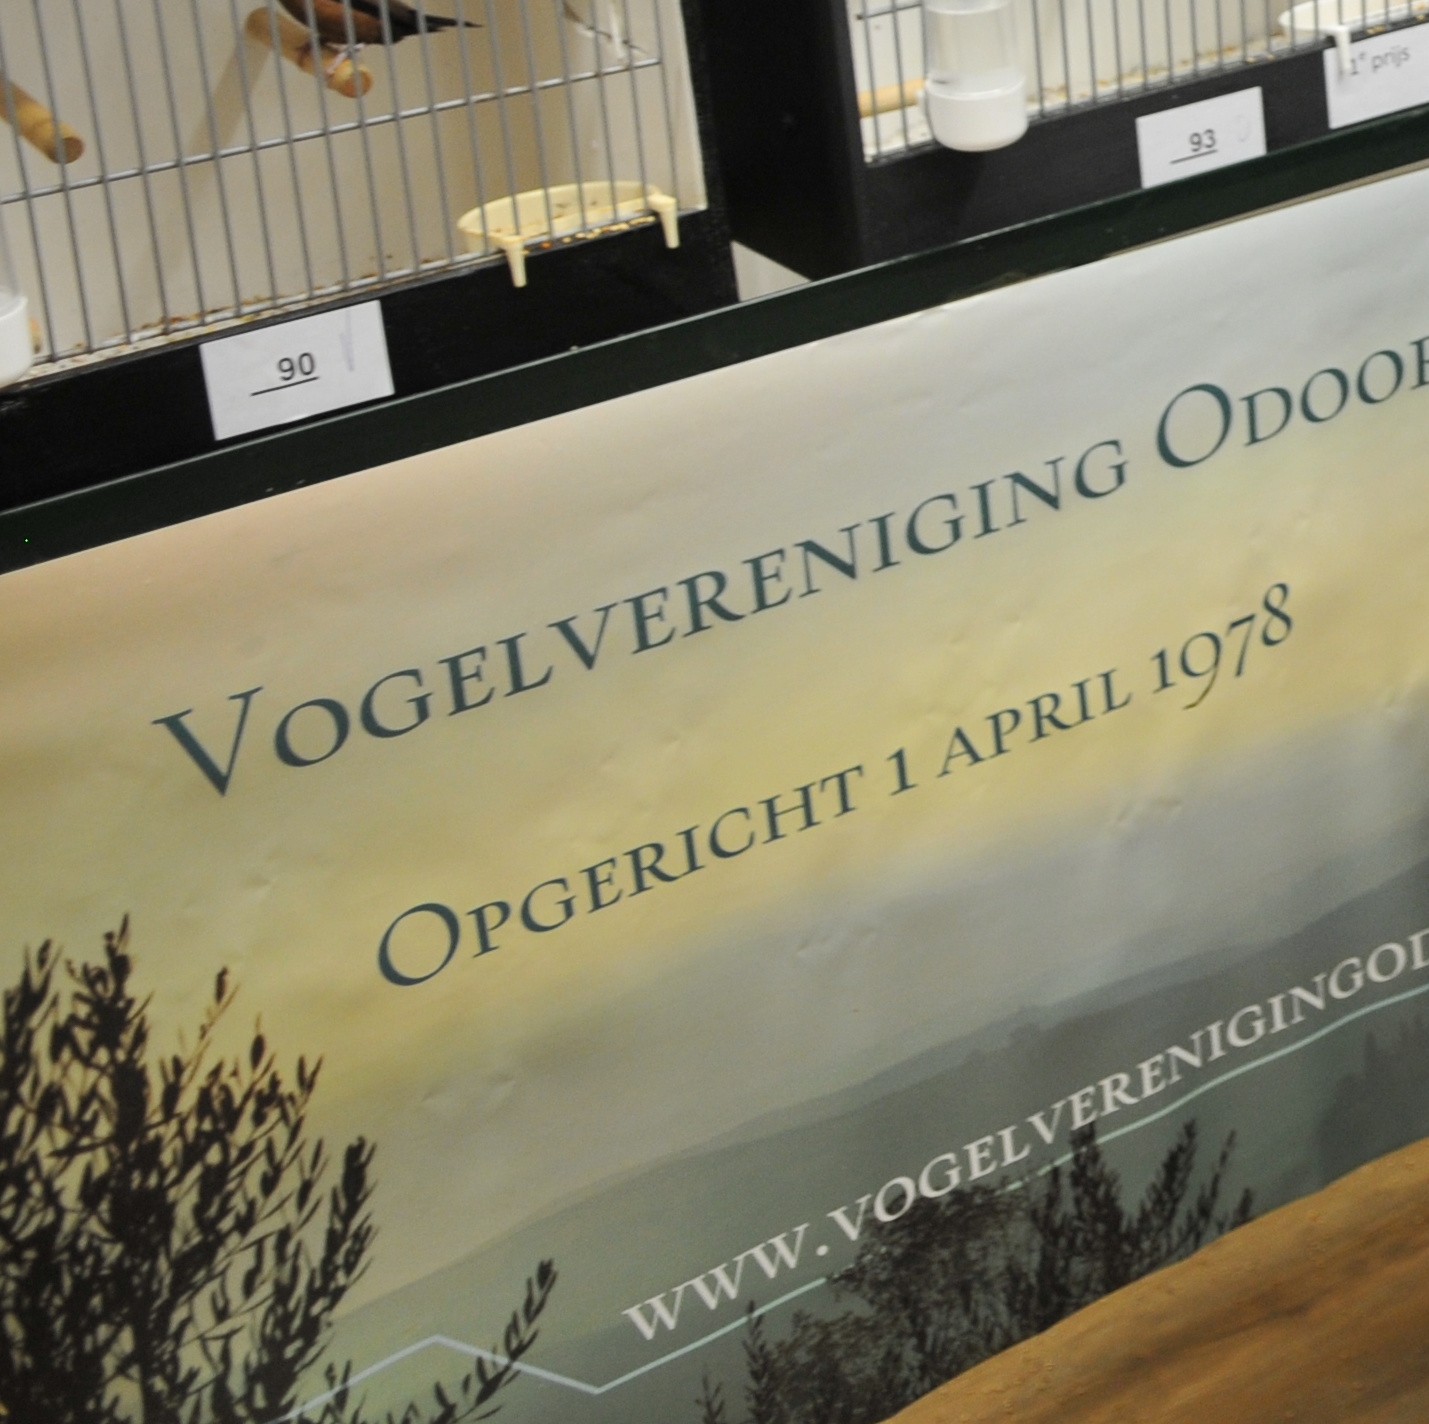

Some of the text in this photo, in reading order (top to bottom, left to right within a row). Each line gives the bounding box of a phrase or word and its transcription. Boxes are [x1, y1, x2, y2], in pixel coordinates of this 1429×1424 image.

[1372, 44, 1411, 73] prijs
[1189, 129, 1217, 153] 93
[278, 351, 316, 382] 90
[886, 747, 919, 798] 1
[936, 667, 1132, 778] APRIL
[1149, 581, 1294, 710] 1978
